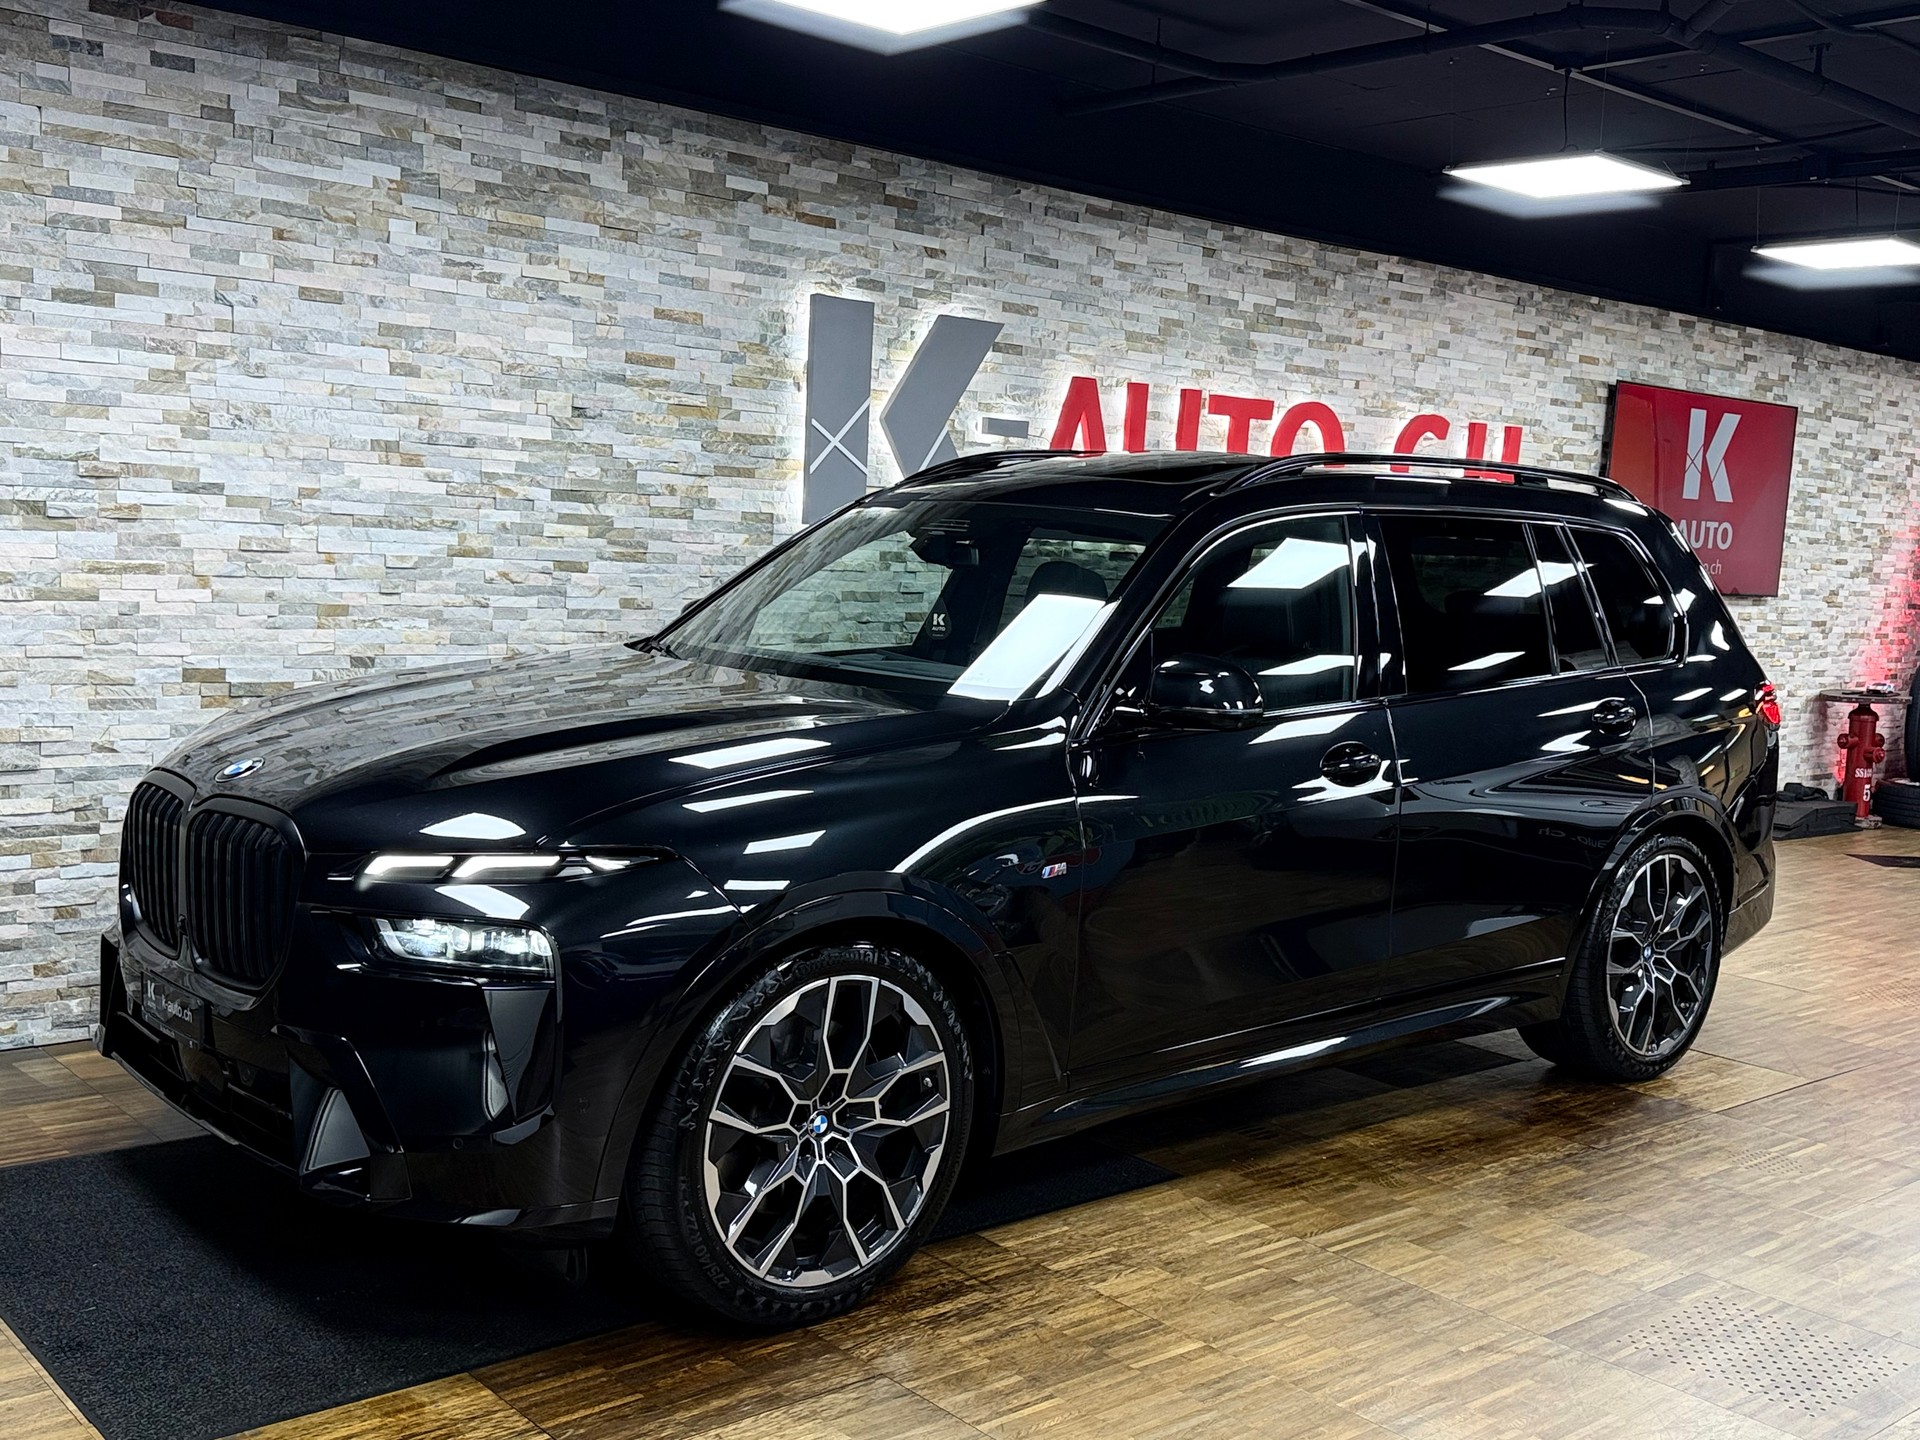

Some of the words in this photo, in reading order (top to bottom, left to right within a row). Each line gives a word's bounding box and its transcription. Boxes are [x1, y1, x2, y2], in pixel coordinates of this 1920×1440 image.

[1682, 407, 1742, 503] K
[932, 613, 946, 626] K
[1863, 784, 1871, 802] 5
[161, 994, 193, 1023] k-auto.ch
